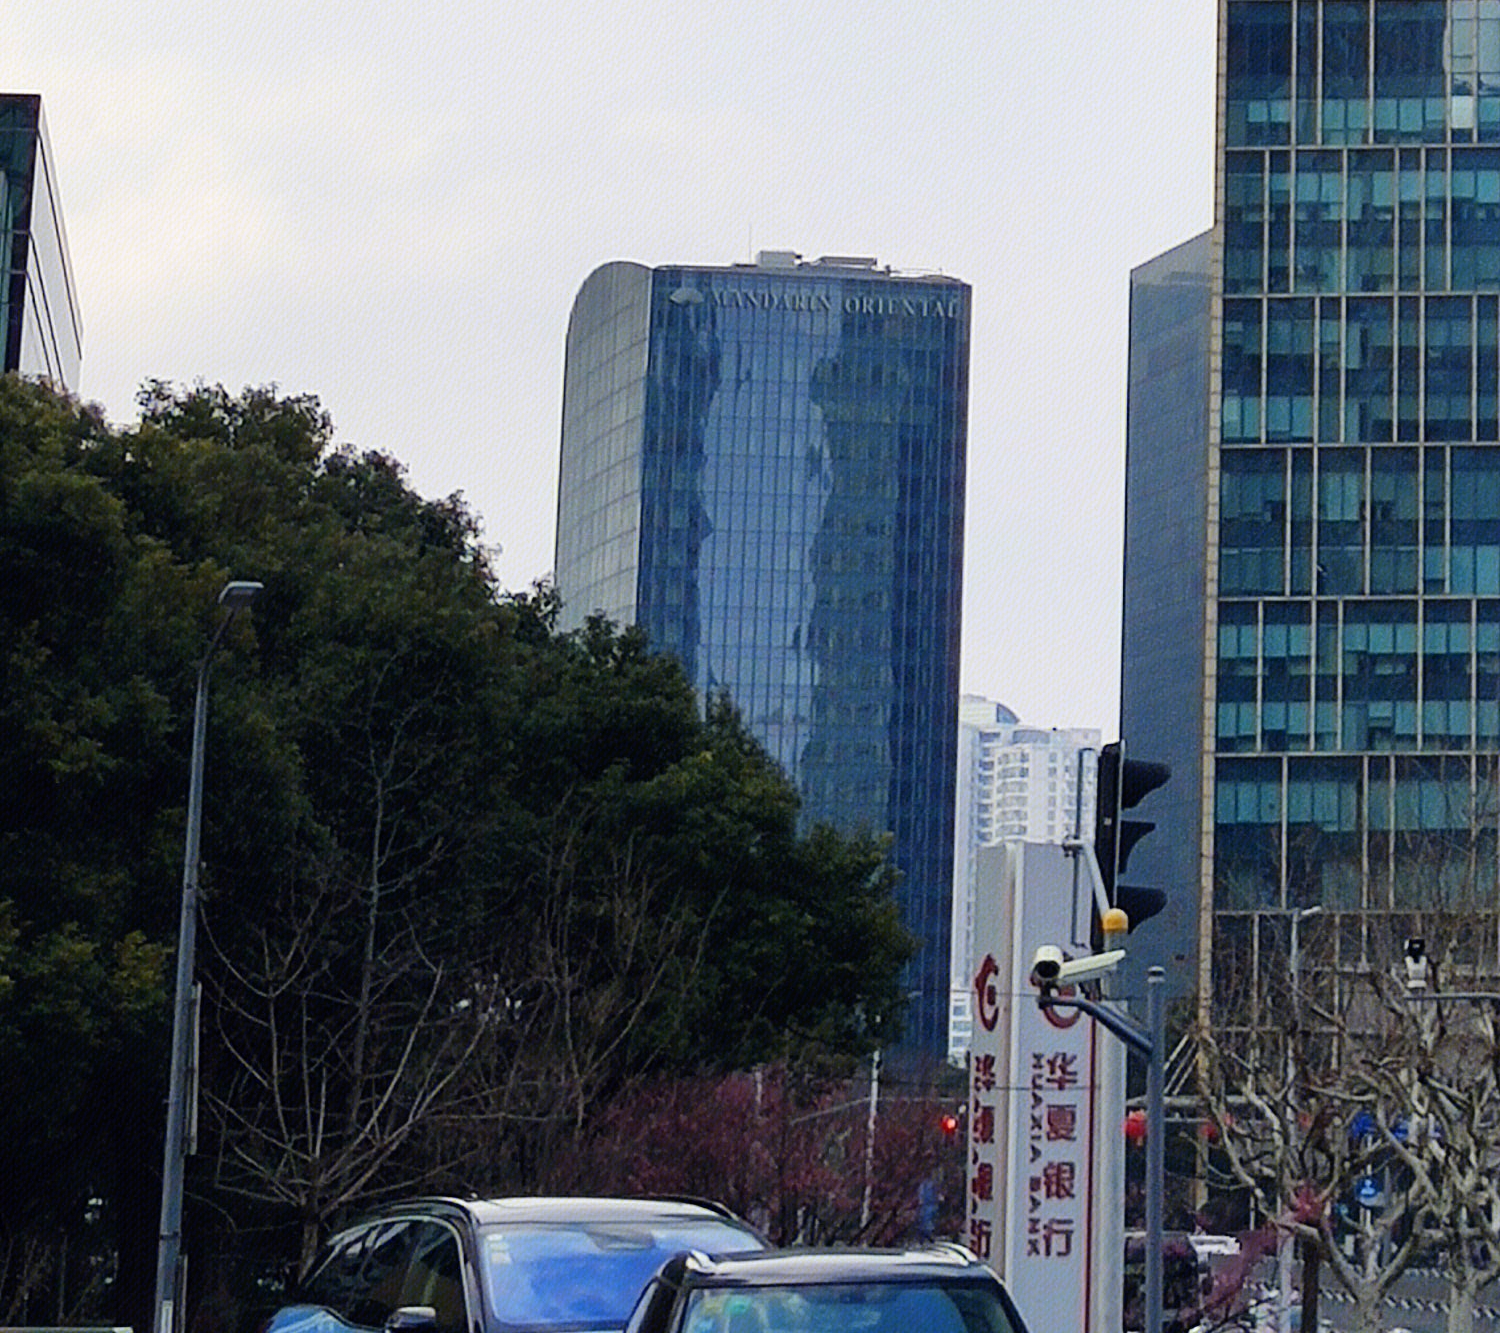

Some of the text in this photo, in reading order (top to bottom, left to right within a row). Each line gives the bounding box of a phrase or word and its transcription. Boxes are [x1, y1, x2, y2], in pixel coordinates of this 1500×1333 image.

[712, 288, 958, 318] MANDARIN ORIENTAL
[1027, 1052, 1044, 1257] HUAXIA BANK
[1043, 1052, 1078, 1257] 华夏银行
